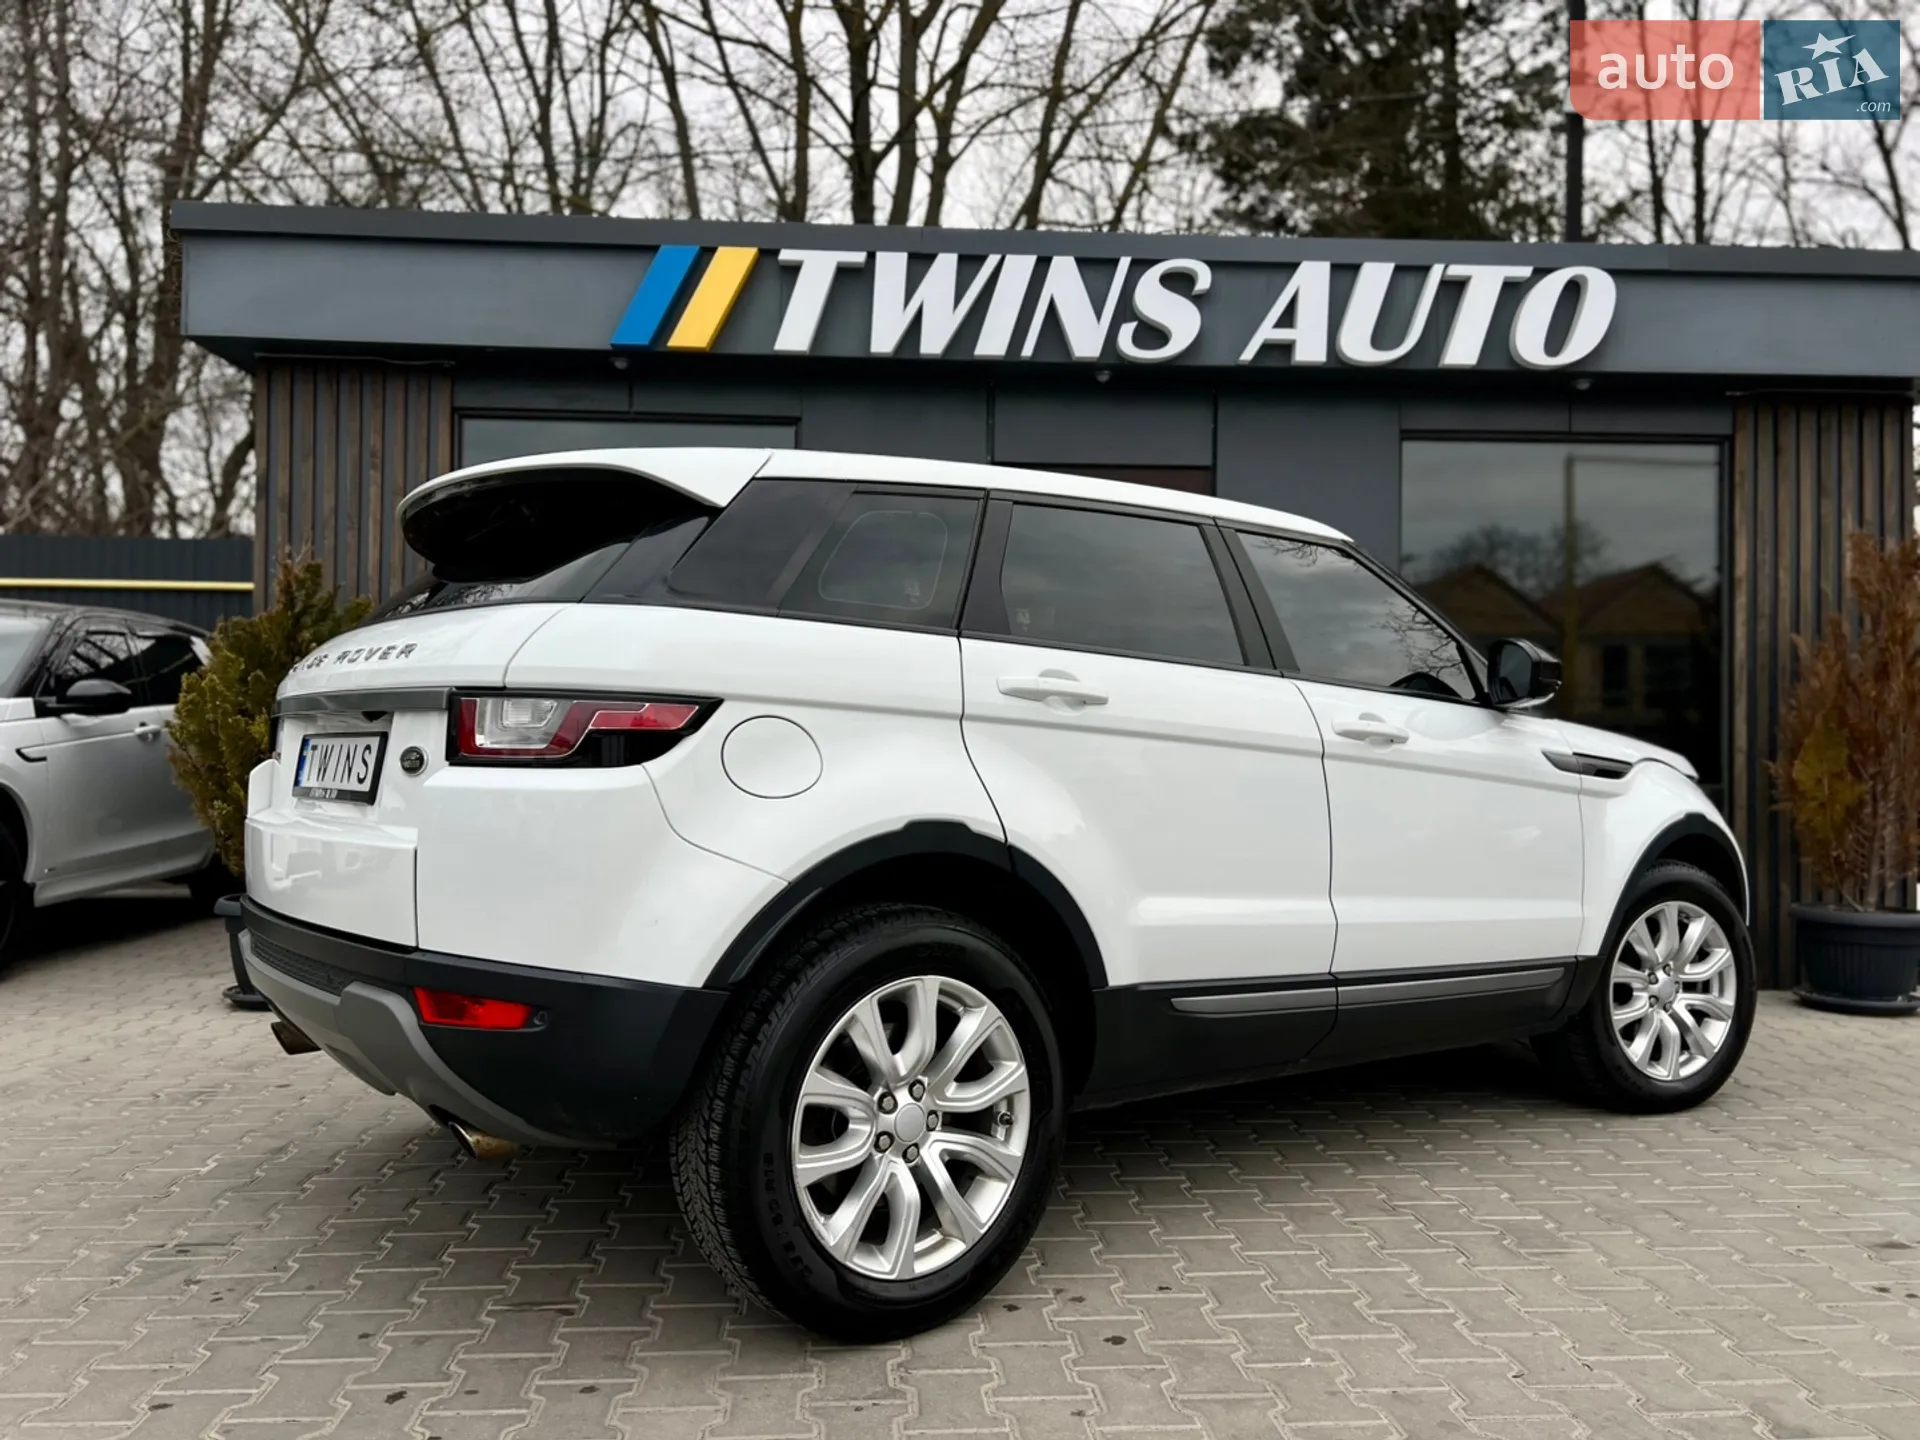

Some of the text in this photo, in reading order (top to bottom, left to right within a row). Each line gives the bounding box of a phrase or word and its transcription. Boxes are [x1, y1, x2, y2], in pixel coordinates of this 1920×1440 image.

[772, 248, 1619, 370] TWINS AUTO
[332, 642, 418, 664] ROVER
[307, 743, 372, 785] TWINS
